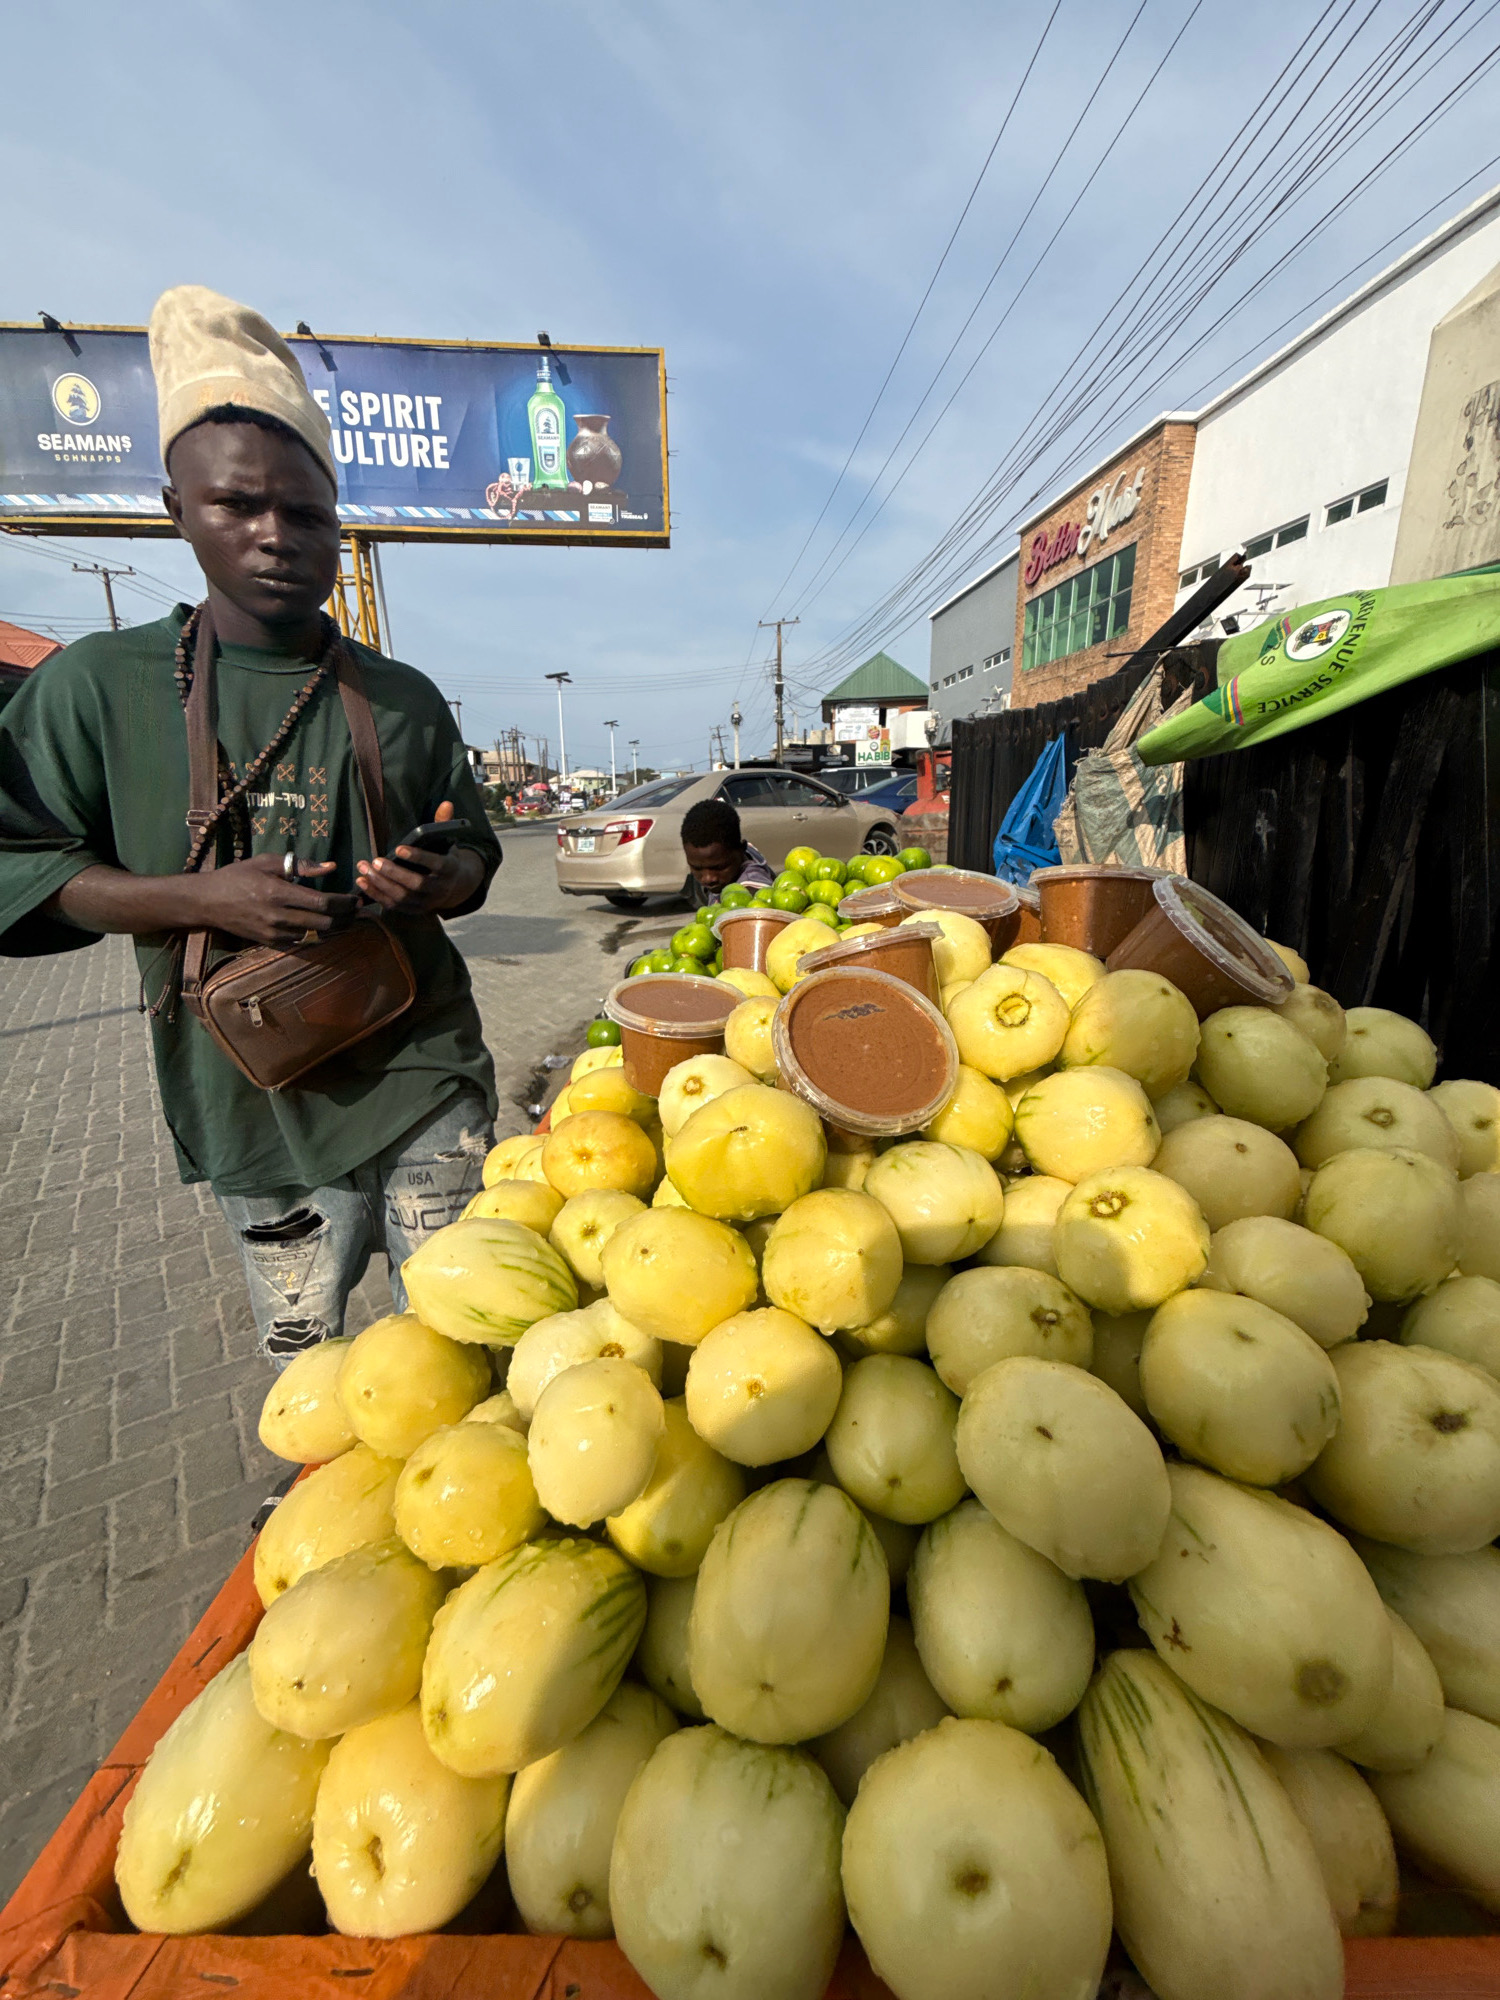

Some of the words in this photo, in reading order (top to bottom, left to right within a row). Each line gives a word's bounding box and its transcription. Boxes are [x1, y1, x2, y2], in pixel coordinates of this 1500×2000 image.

[340, 390, 442, 430] SPIRIT
[37, 433, 132, 453] SEAMANS
[331, 429, 450, 469] ULTURE
[54, 453, 122, 464] SCHNAPPS
[1328, 599, 1376, 673] REVENUE
[1257, 673, 1333, 714] SERVICE
[857, 751, 891, 762] HABIB
[407, 1171, 434, 1185] USA
